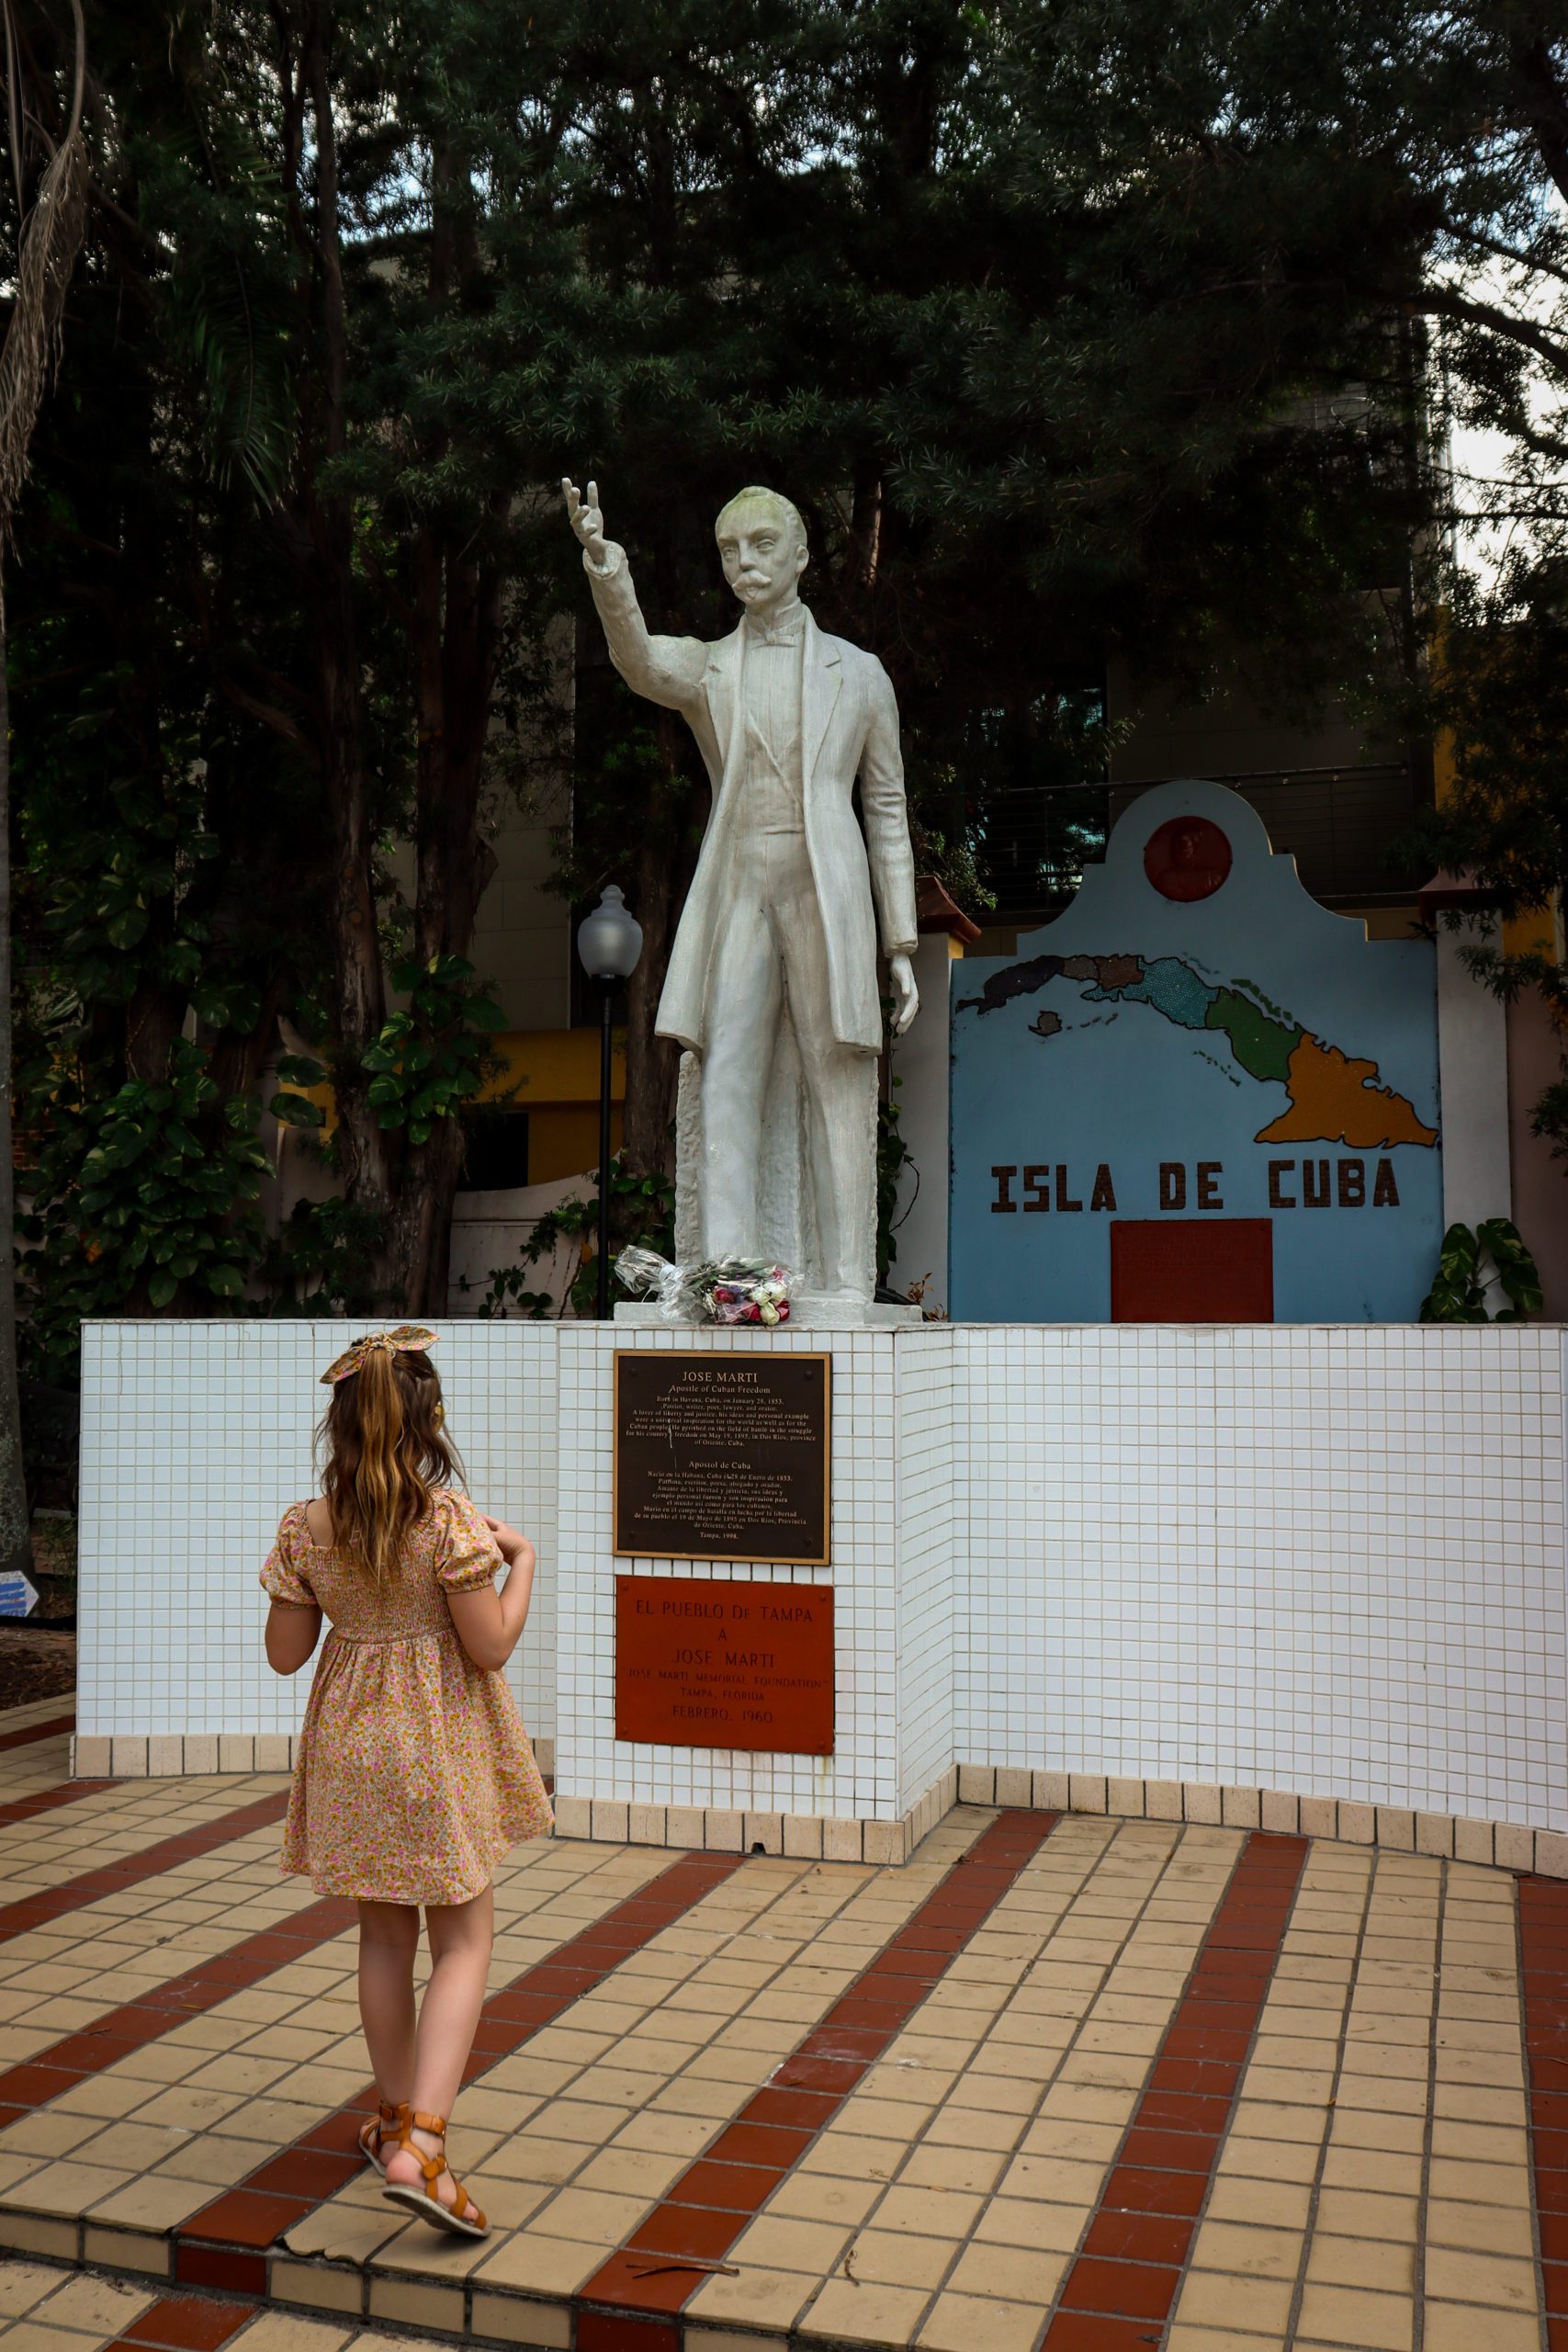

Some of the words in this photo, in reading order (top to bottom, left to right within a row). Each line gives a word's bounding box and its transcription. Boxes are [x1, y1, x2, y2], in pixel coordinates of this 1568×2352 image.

[990, 1163, 1117, 1213] ISLA
[1158, 1161, 1224, 1211] DE
[1268, 1158, 1401, 1208] CUBA
[682, 1371, 713, 1382] JOSE
[716, 1372, 758, 1383] MARTI
[671, 1385, 699, 1393] Apostle
[711, 1385, 735, 1393] Cuban
[738, 1385, 771, 1394] Freedom
[662, 1409, 682, 1418] liberty
[682, 1424, 706, 1432] perished
[688, 1461, 717, 1470] Apostol
[719, 1461, 729, 1469] de
[731, 1462, 751, 1470] Cuba
[637, 1600, 654, 1615] EL
[662, 1601, 724, 1619] PUEBLO
[761, 1606, 813, 1622] TAMPA
[718, 1629, 727, 1641] A
[671, 1649, 713, 1665] JOSE
[726, 1652, 774, 1668] MARTI
[659, 1670, 689, 1680] MARTI
[695, 1673, 747, 1684] MEMORIAL
[723, 1690, 764, 1702] FLORIDA
[742, 1710, 773, 1724] 1960
